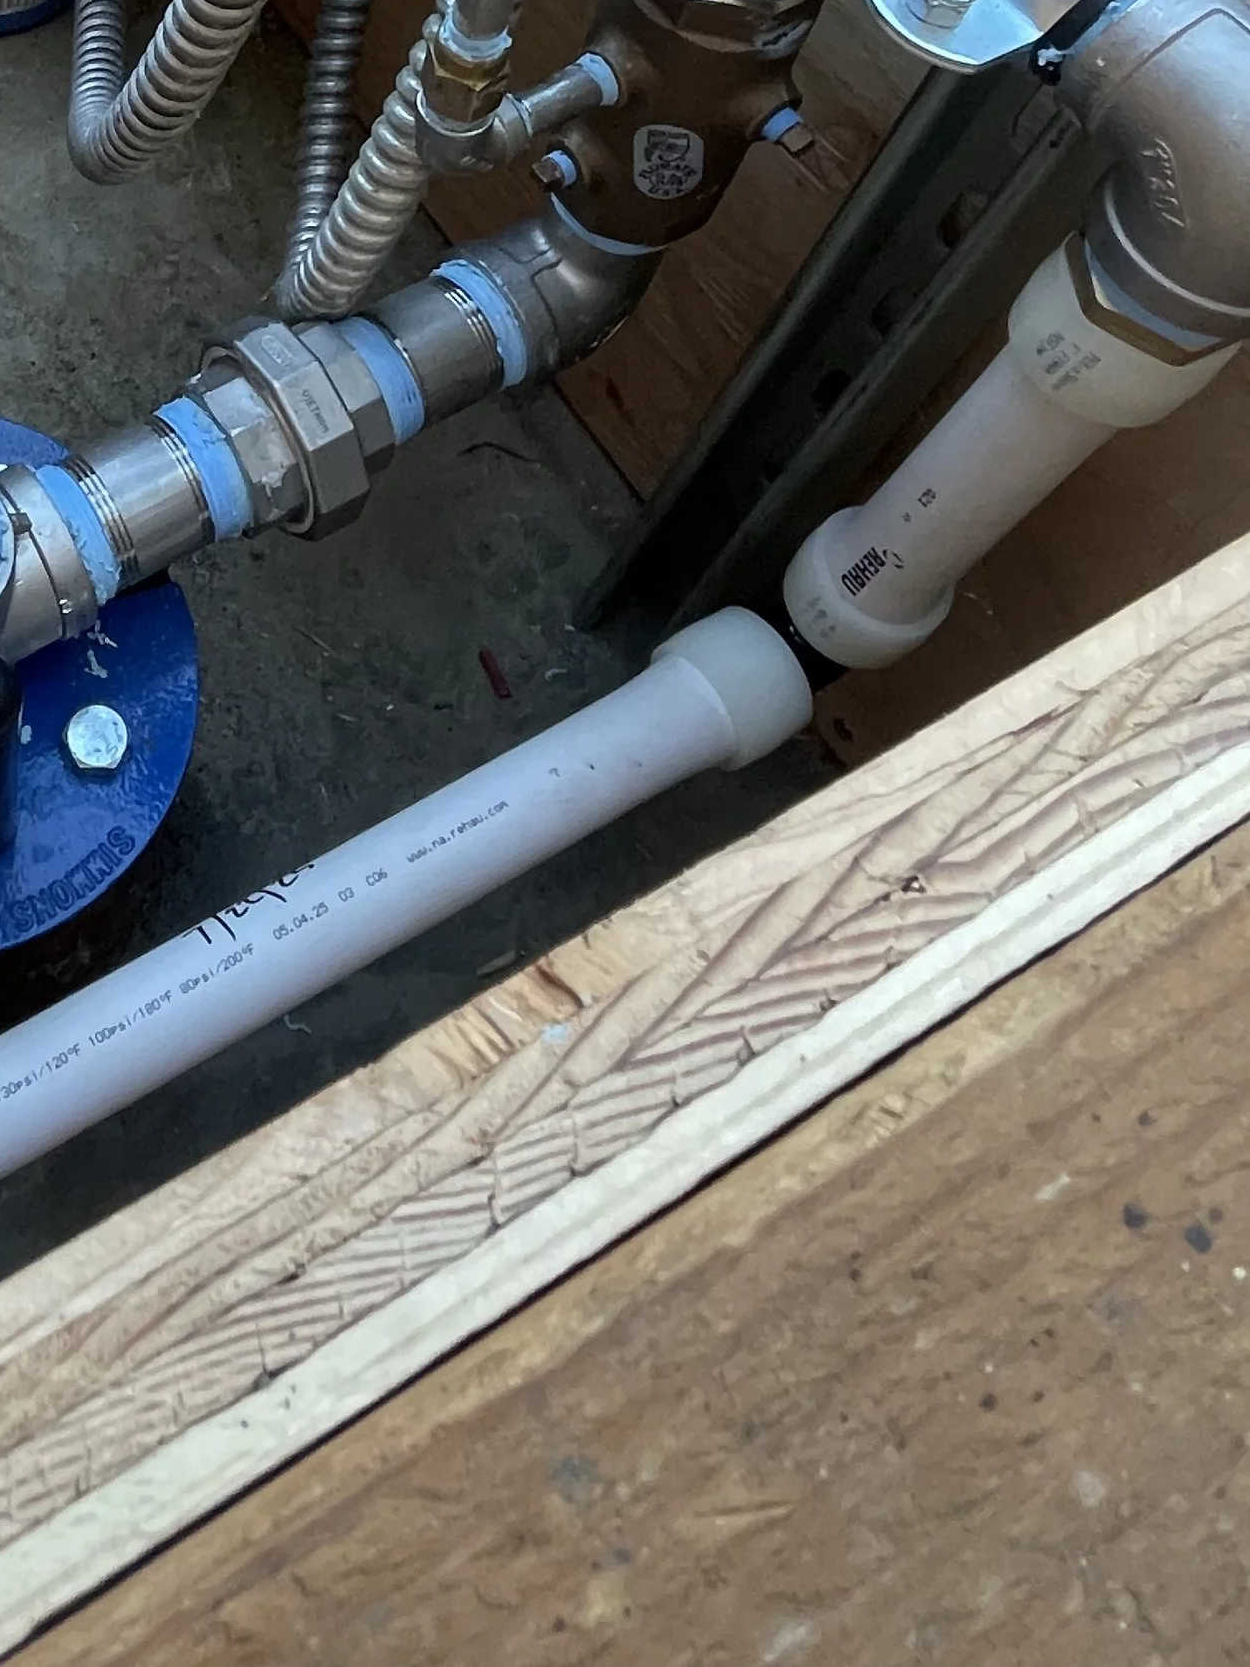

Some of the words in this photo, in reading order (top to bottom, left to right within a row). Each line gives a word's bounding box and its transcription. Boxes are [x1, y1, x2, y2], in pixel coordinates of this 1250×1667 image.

[841, 547, 887, 597] REHAU
[10, 825, 136, 934] SIMMONS
[270, 900, 330, 942] 05.04.25
[404, 796, 510, 864] www.na.rehau.com
